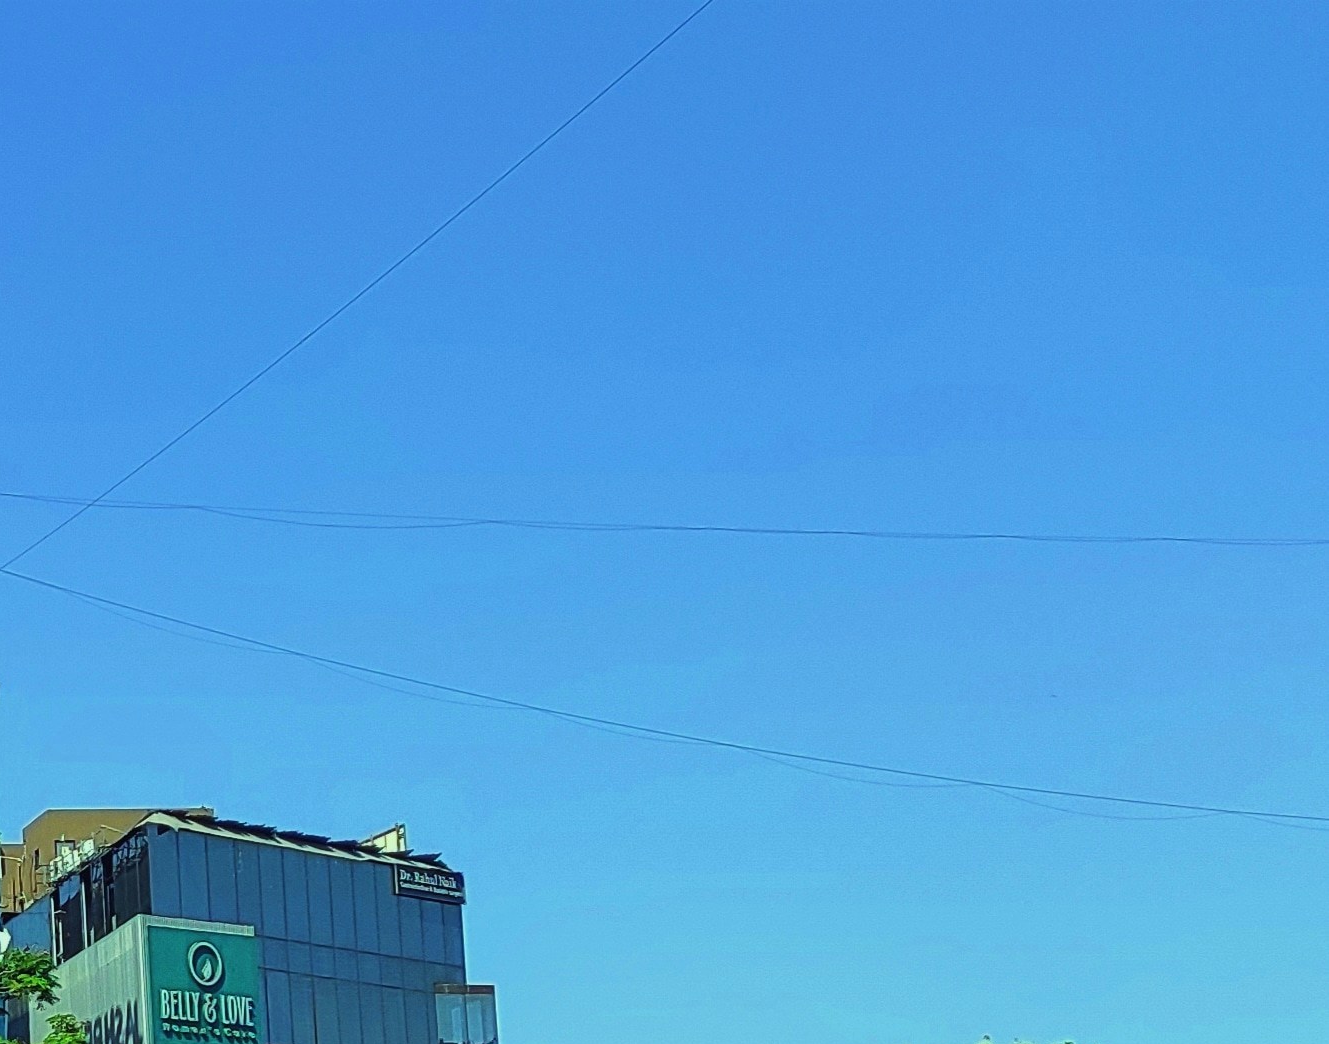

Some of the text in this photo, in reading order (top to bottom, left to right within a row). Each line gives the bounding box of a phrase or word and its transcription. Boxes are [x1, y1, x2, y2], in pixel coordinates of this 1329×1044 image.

[160, 988, 255, 1027] BELLY & LOVE
